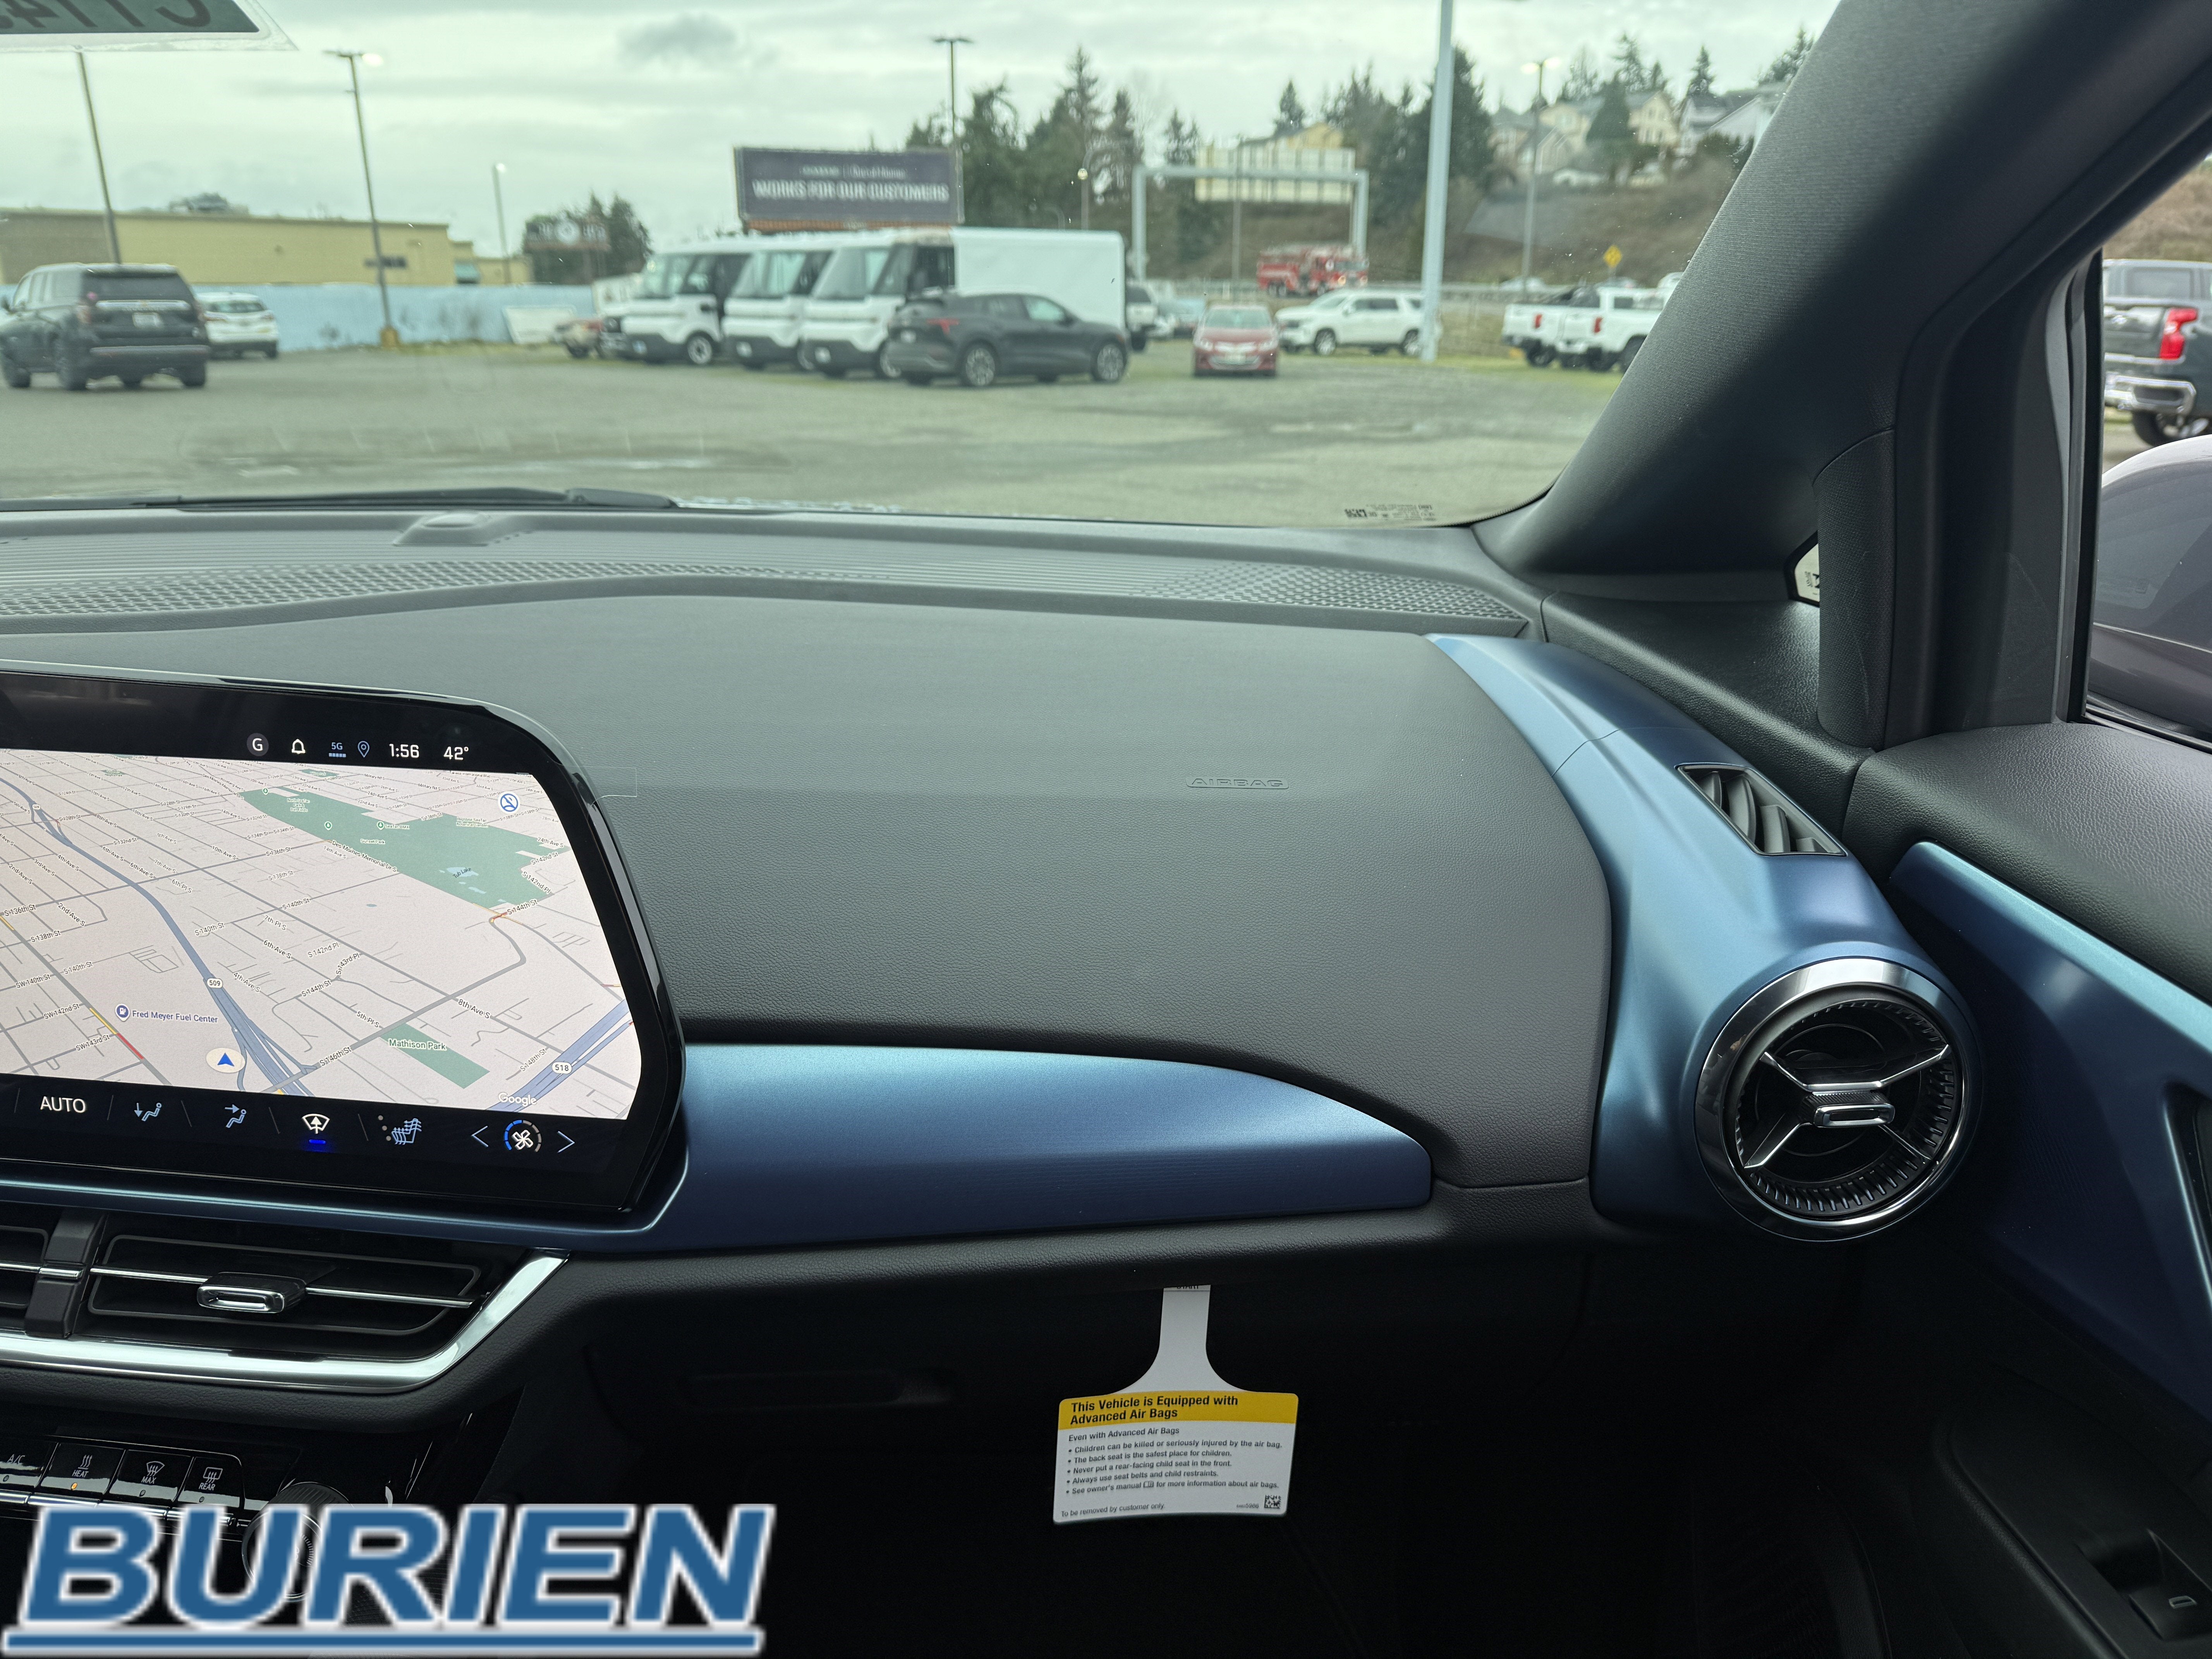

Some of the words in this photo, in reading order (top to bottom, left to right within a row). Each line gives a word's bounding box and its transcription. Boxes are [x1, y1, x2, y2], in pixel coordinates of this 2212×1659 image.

[252, 738, 263, 751] G
[389, 744, 419, 758] 1:56
[443, 747, 469, 760] 42°
[1192, 778, 1283, 787] AIRBAG
[10, 906, 27, 915] 136th
[513, 902, 530, 912] 144th
[58, 903, 70, 914] 2nd
[70, 912, 80, 922] Ave
[265, 915, 273, 924] 7th
[201, 925, 217, 933] 140th
[36, 932, 53, 941] 138th
[264, 940, 273, 949] 6th
[275, 946, 286, 955] Ave
[314, 945, 331, 955] 142nd
[338, 957, 352, 969] 143rd
[27, 976, 43, 985] 140th
[234, 972, 243, 982] 4th
[244, 979, 254, 989] Ave
[307, 984, 324, 994] 144th
[55, 1006, 72, 1015] 142nd
[459, 999, 470, 1009] 8th
[471, 1006, 483, 1015] Ave
[151, 1012, 173, 1020] Meyer
[357, 1012, 367, 1020] 5th
[86, 1037, 103, 1046] 143rd
[389, 1039, 425, 1048] Mathison
[325, 1050, 343, 1063] 146th
[525, 1054, 540, 1067] 148th
[499, 1092, 536, 1106] Google
[40, 1096, 86, 1113] AUTO
[1071, 1401, 1095, 1412] This
[1099, 1398, 1140, 1409] Vehicle
[1144, 1396, 1153, 1406] is
[1157, 1396, 1209, 1407] Equipped
[1214, 1396, 1238, 1405] with
[1070, 1410, 1126, 1425] Advanced
[1130, 1409, 1146, 1419] Air
[1150, 1409, 1178, 1419] Bags
[1108, 1429, 1145, 1437] Advanced
[1075, 1445, 1105, 1453] Children
[7, 1454, 25, 1463] A/C
[1115, 1461, 1154, 1469] rear-facing
[1073, 1475, 1097, 1484] Always
[1080, 1506, 1108, 1515] removed
